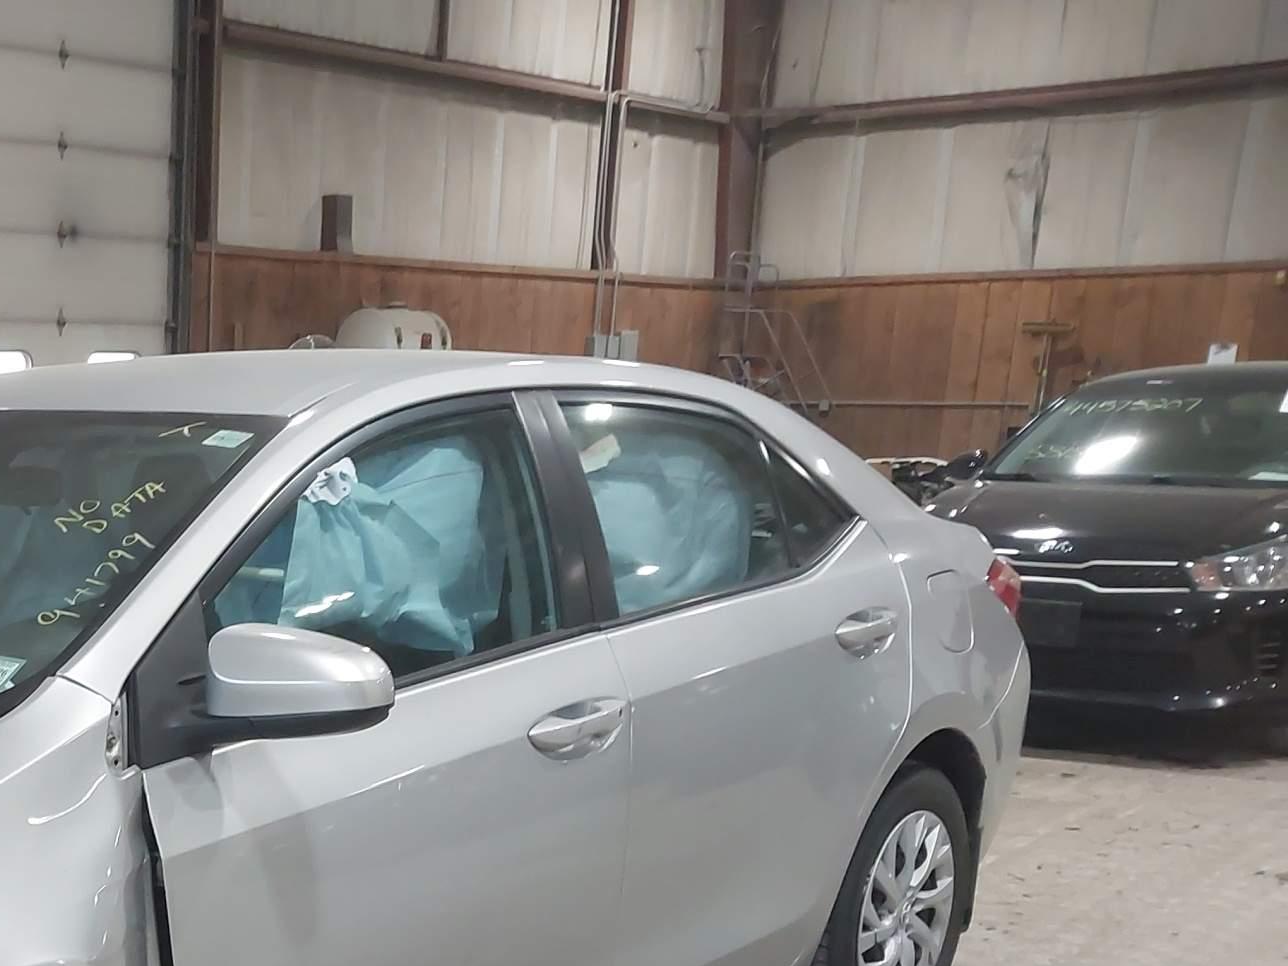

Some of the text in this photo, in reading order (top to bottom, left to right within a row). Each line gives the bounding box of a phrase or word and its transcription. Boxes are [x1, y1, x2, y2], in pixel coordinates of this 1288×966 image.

[54, 500, 101, 533] NO
[82, 481, 166, 534] DATA
[37, 533, 156, 625] 941799
